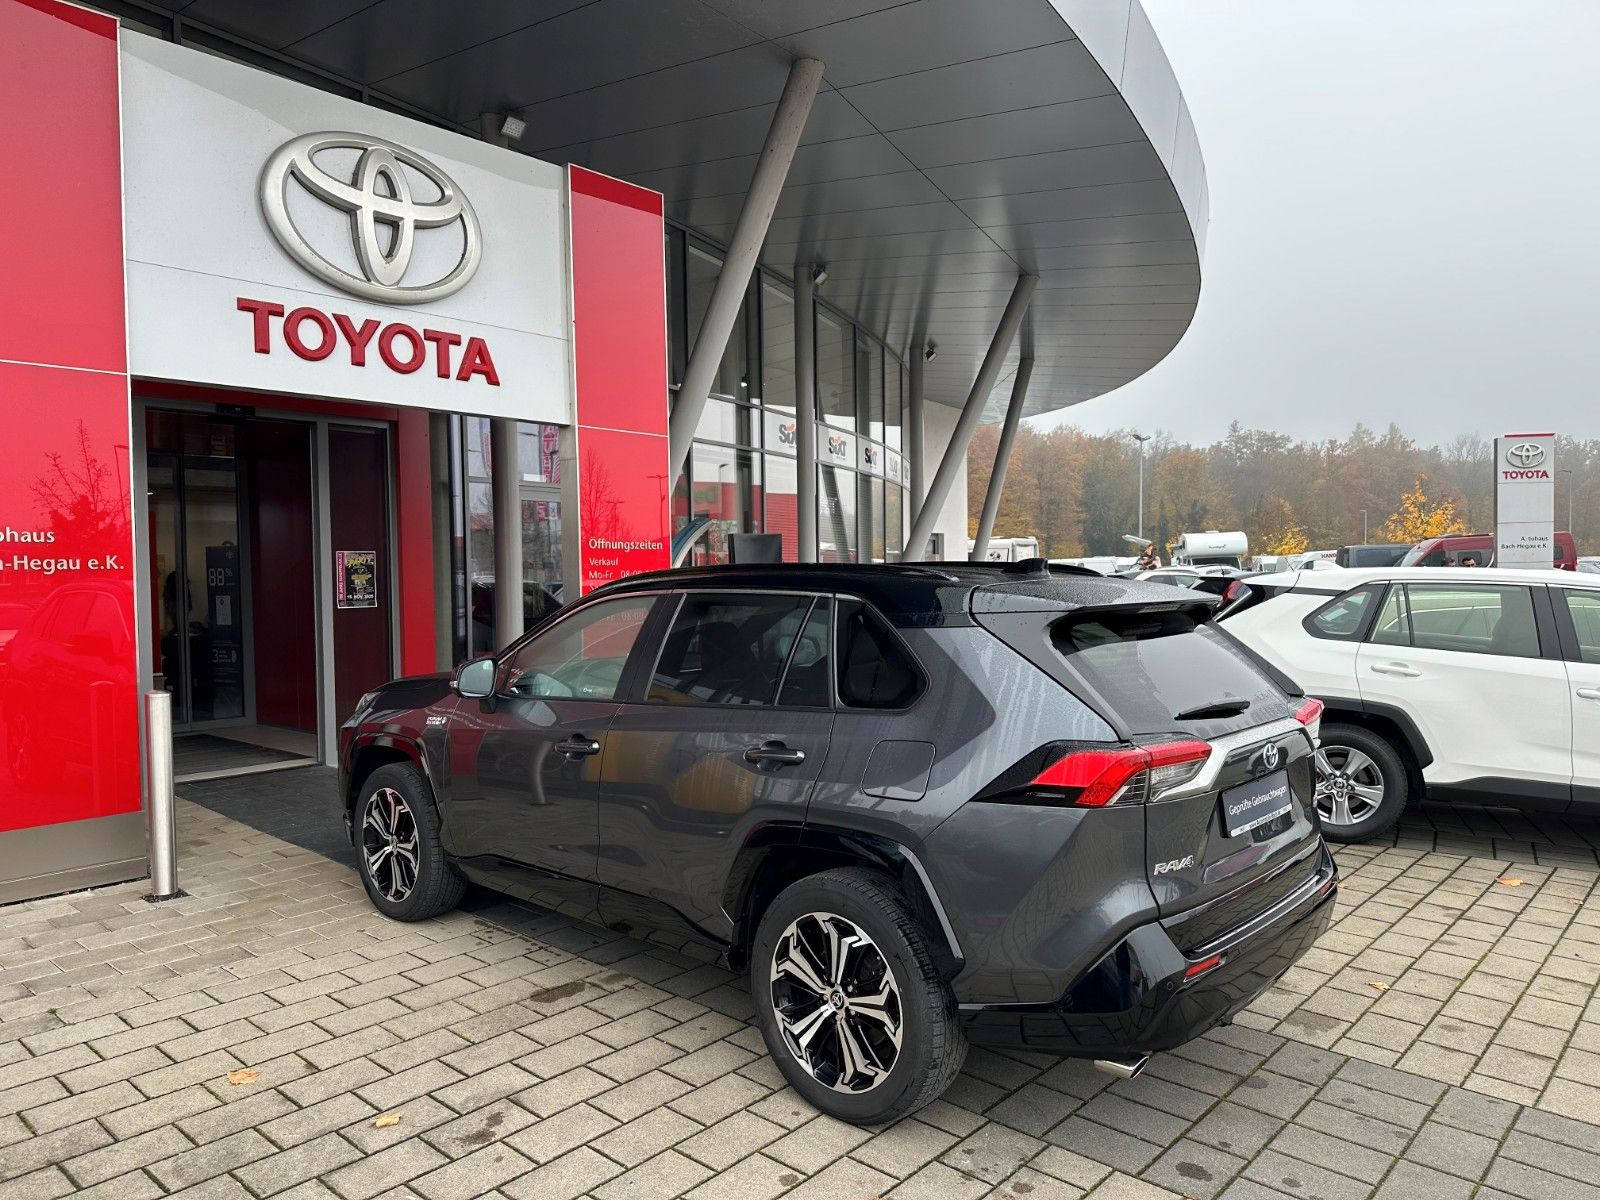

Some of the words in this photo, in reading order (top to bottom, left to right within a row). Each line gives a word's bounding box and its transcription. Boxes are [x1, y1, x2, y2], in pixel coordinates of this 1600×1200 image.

[237, 297, 500, 386] TOYOTA
[1502, 470, 1549, 479] TOYOTA
[588, 536, 663, 552] Öffnungszeiten
[0, 555, 81, 575] -Hegau
[87, 554, 124, 571] e.K.
[588, 557, 619, 566] Verkauf
[588, 570, 613, 579] Mo-Fr
[1153, 854, 1194, 875] RAV4
